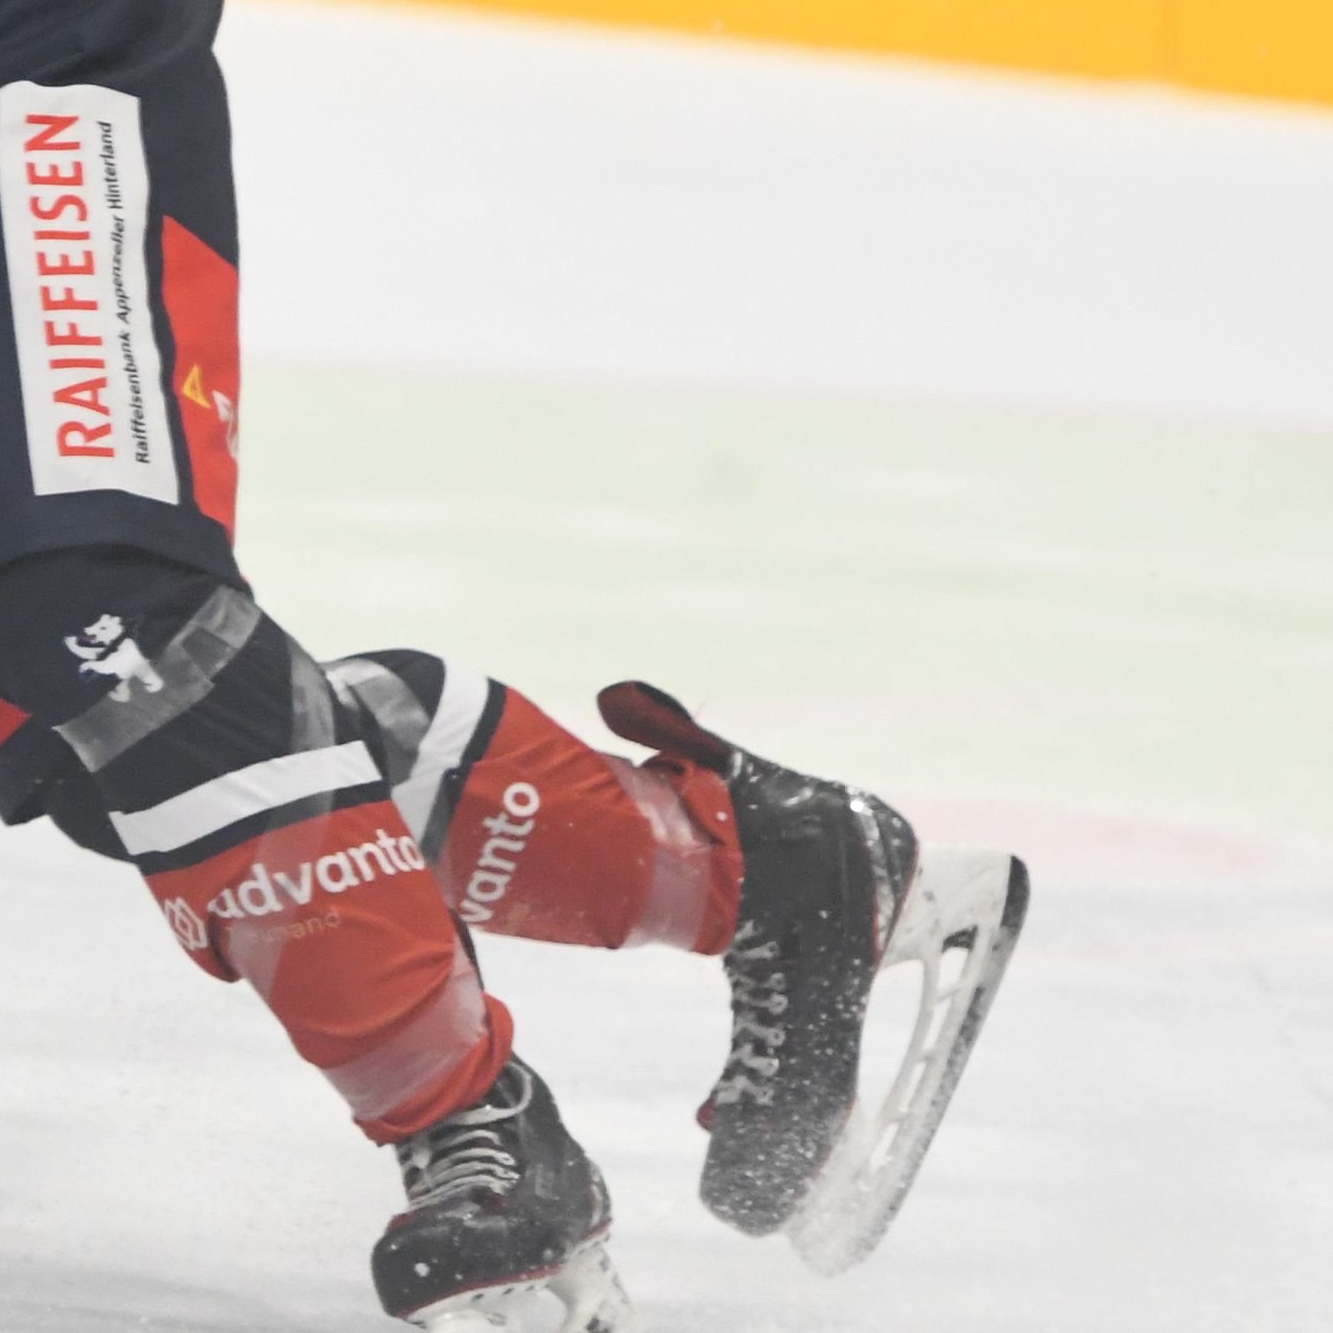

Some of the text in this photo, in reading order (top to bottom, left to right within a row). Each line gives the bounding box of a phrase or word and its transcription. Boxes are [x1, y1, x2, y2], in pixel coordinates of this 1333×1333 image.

[23, 113, 116, 459] RAIFFEISEN
[95, 120, 151, 465] Raiffeisenbank Appenzeller Hinterland
[458, 782, 541, 924] vanto
